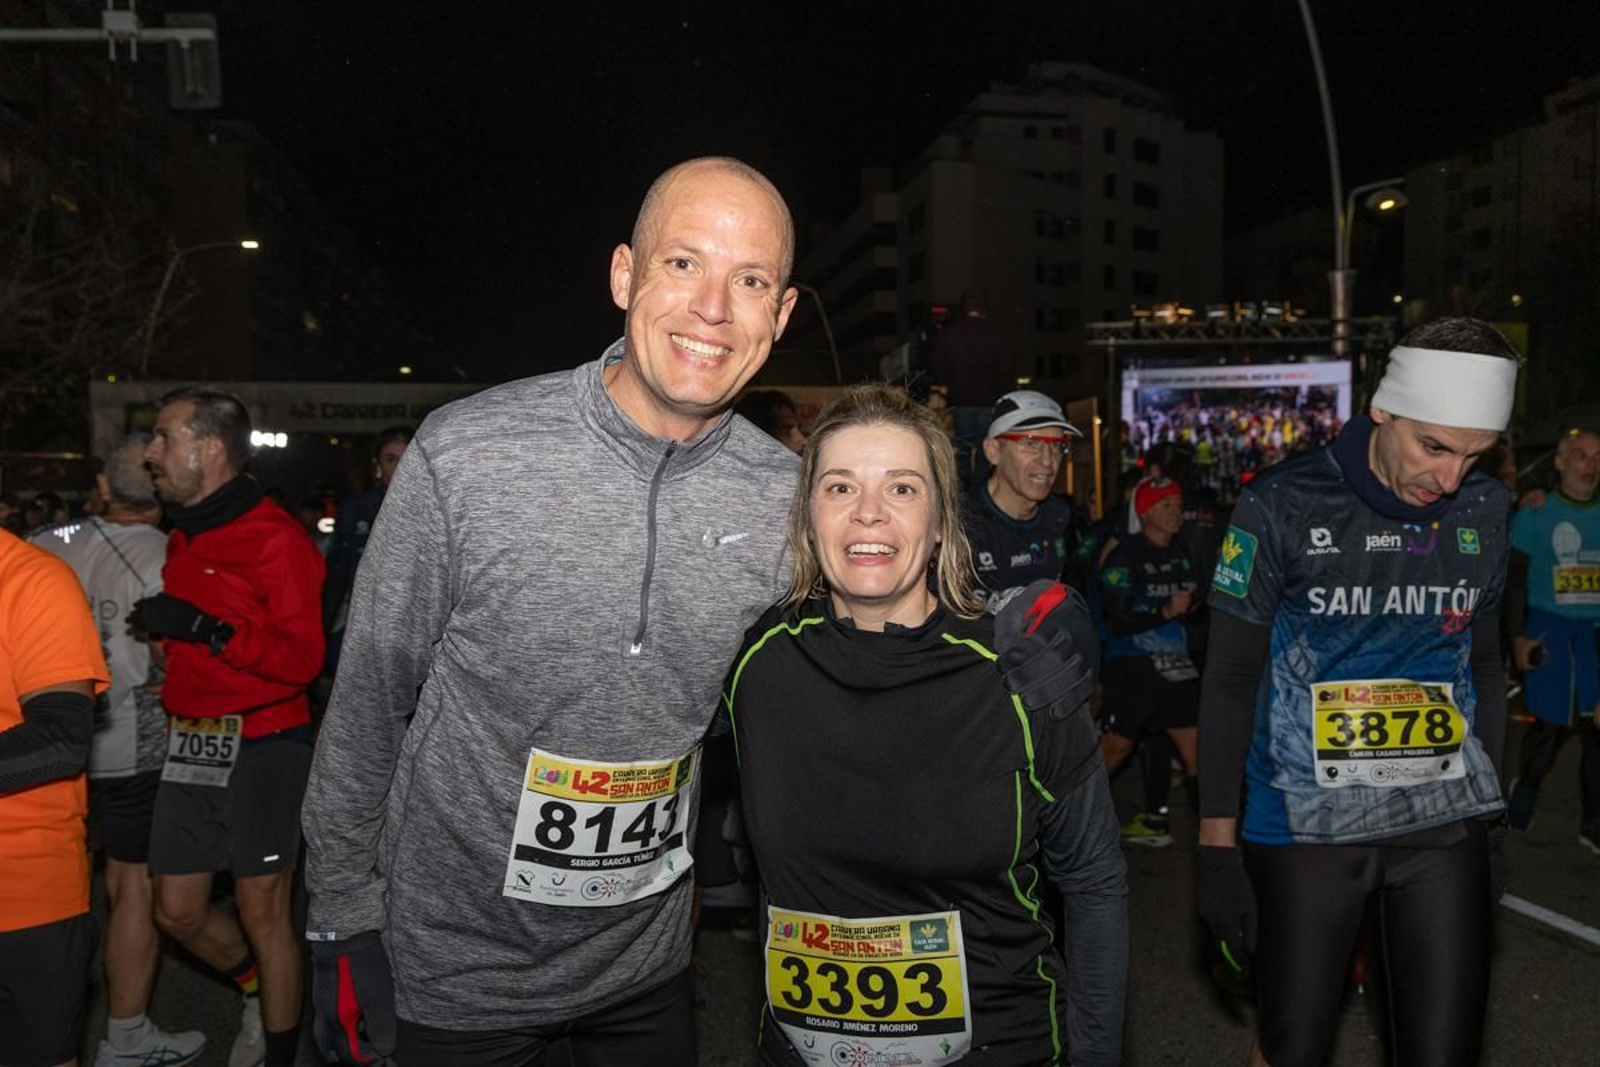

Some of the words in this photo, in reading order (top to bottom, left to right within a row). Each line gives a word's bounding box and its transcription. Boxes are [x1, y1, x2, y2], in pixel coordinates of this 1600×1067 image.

[1307, 586, 1372, 616] SAN
[1326, 708, 1454, 748] 3878
[177, 731, 234, 760] 7055
[572, 769, 611, 796] 42
[609, 784, 634, 795] SAN
[534, 791, 681, 854] 8143
[570, 858, 600, 868] SERGIO
[602, 856, 631, 867] GARCÍA
[801, 922, 830, 951] 42
[831, 939, 854, 953] SAN
[781, 956, 947, 1018] 3393
[806, 1016, 840, 1029] ROSARIO
[843, 1018, 876, 1032] JIMÉNEZ
[879, 1022, 918, 1032] MORENO
